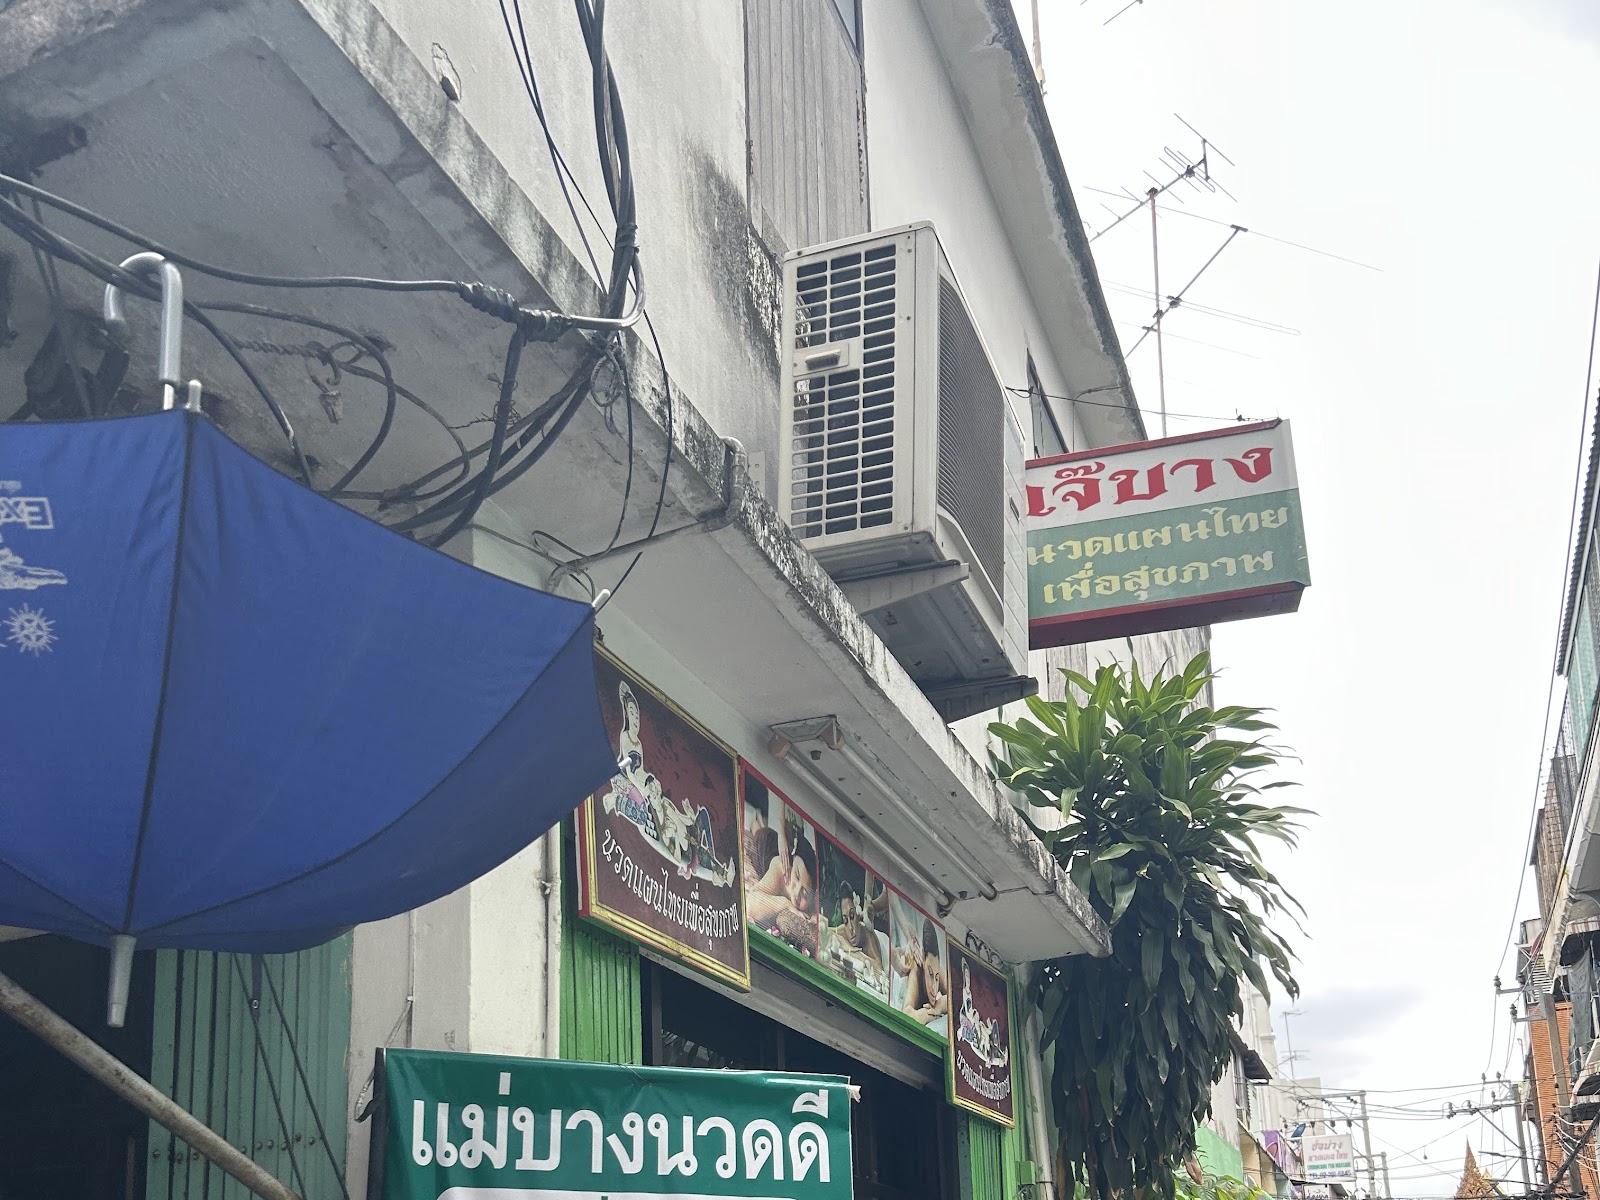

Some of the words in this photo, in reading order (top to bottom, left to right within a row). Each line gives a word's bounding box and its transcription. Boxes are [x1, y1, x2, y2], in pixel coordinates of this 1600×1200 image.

[1026, 446, 1274, 517] เจ๊บาง
[1027, 506, 1288, 566] นวดแผนไทย
[1043, 550, 1274, 601] เพื่อสุขภาพ
[602, 829, 739, 950] นวดแผนไทยเพื่อสุขภาพ
[411, 1071, 831, 1183] แม่บางนวดดี
